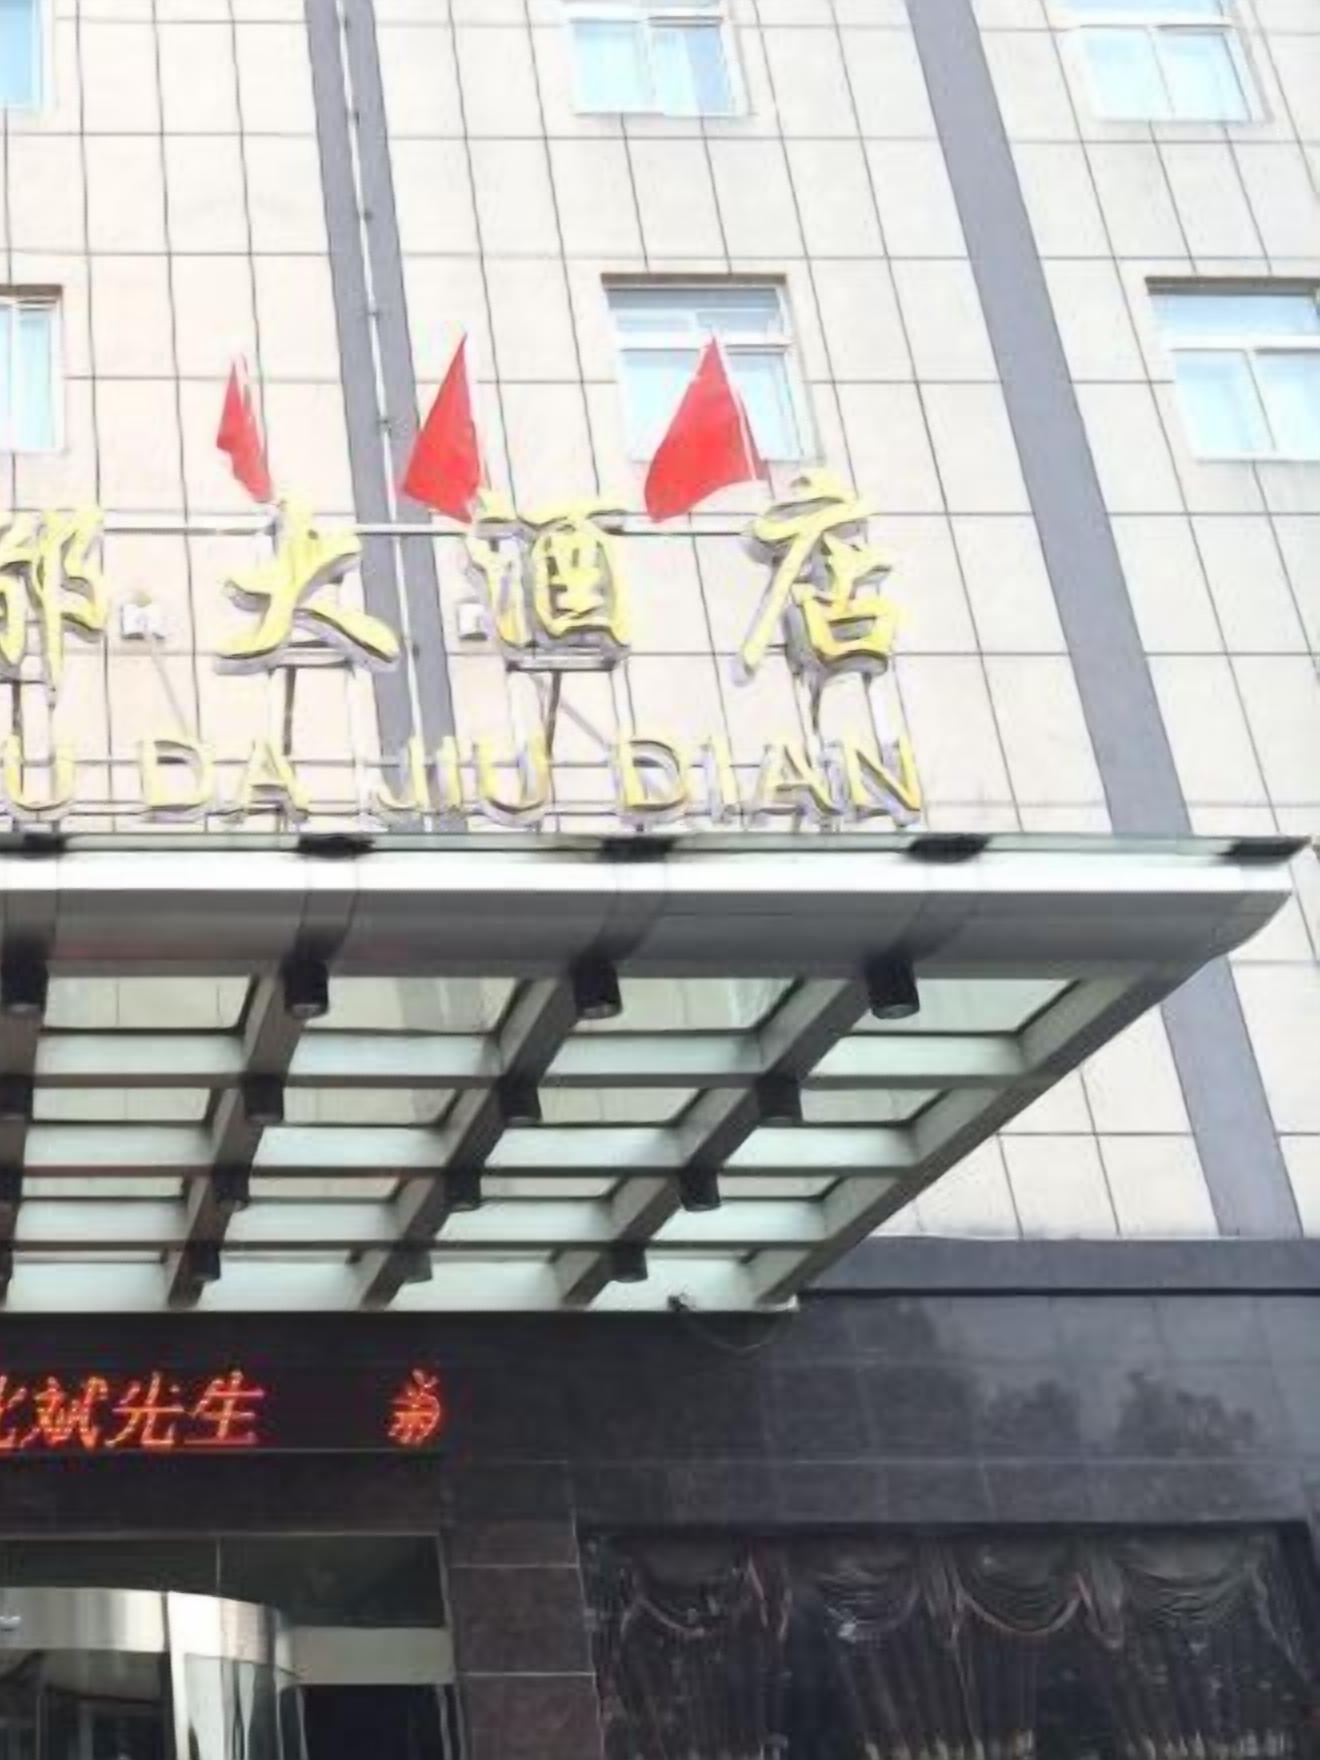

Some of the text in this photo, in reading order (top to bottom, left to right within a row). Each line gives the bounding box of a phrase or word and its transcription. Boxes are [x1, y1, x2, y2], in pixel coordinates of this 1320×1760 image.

[136, 736, 310, 824] DA
[370, 732, 548, 826] JIU
[614, 732, 926, 826] DIAN
